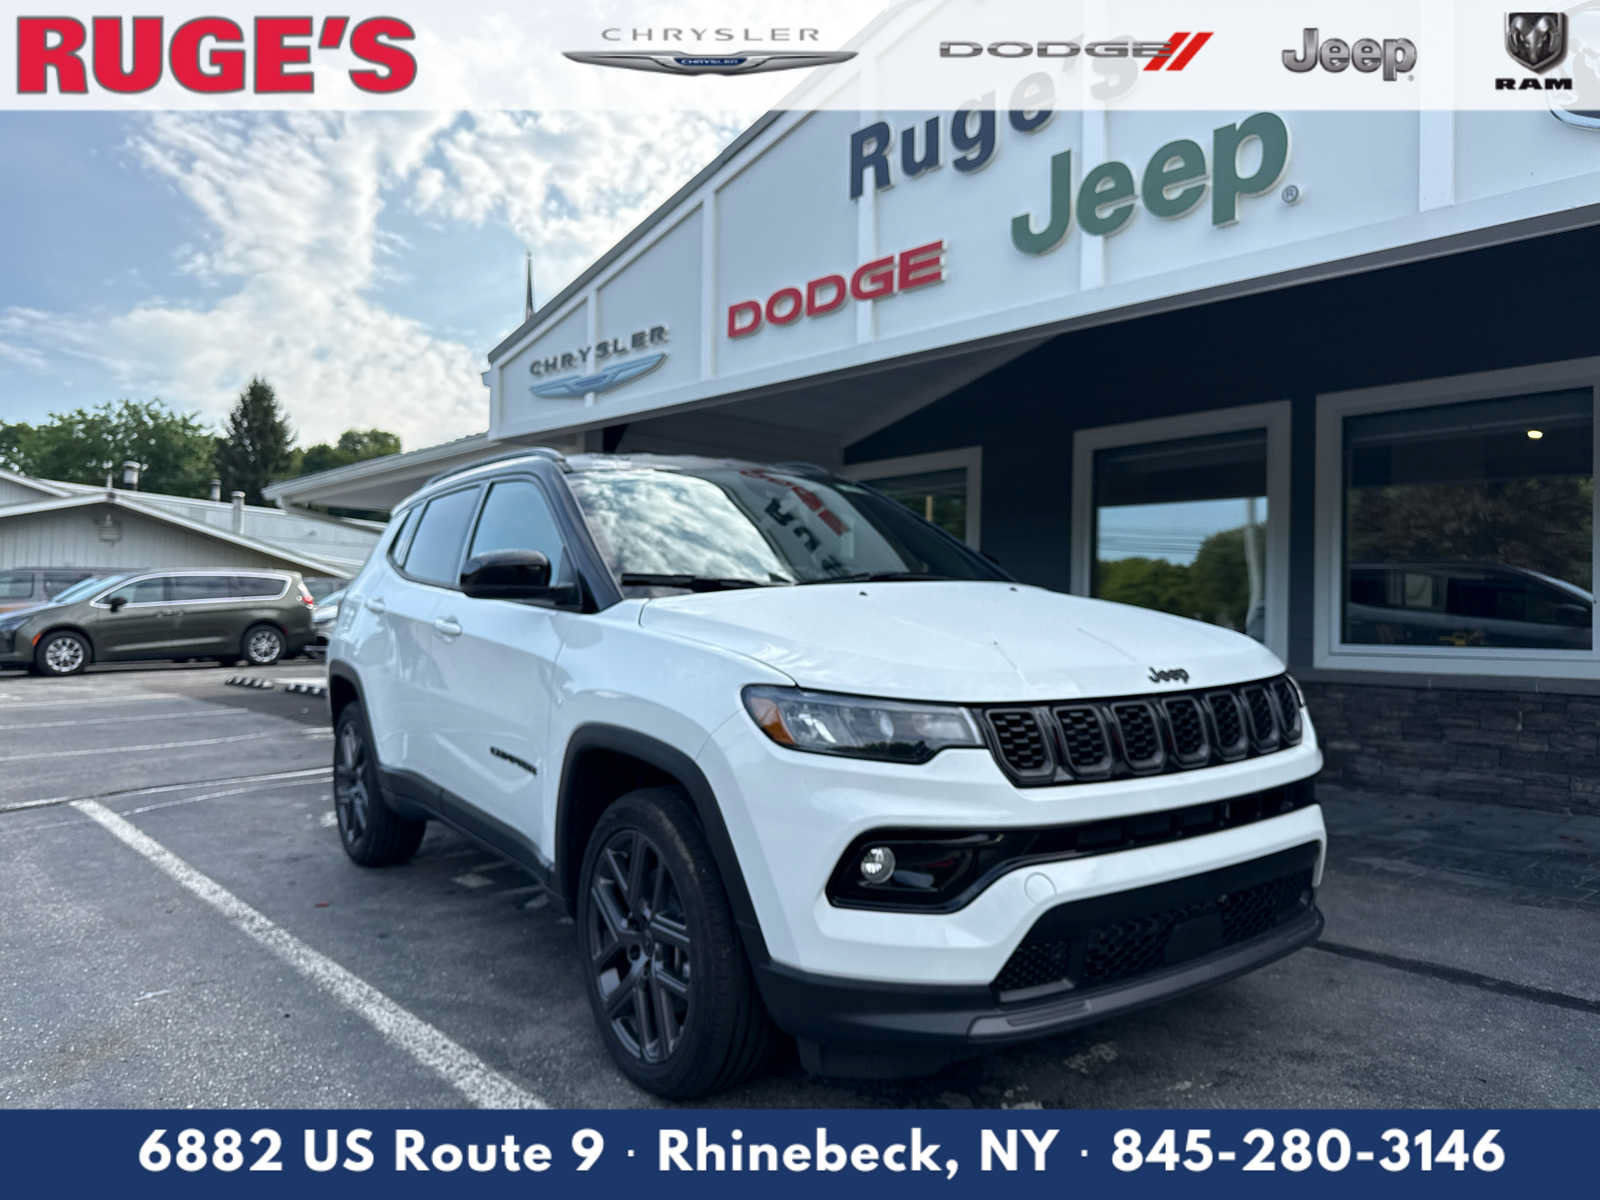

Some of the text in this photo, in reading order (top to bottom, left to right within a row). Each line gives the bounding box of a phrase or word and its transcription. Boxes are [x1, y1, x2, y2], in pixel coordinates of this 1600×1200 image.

[1010, 111, 1290, 256] Jeep
[727, 240, 944, 339] DODGE
[530, 325, 668, 377] CHRYSLER
[1148, 666, 1190, 684] Jeep
